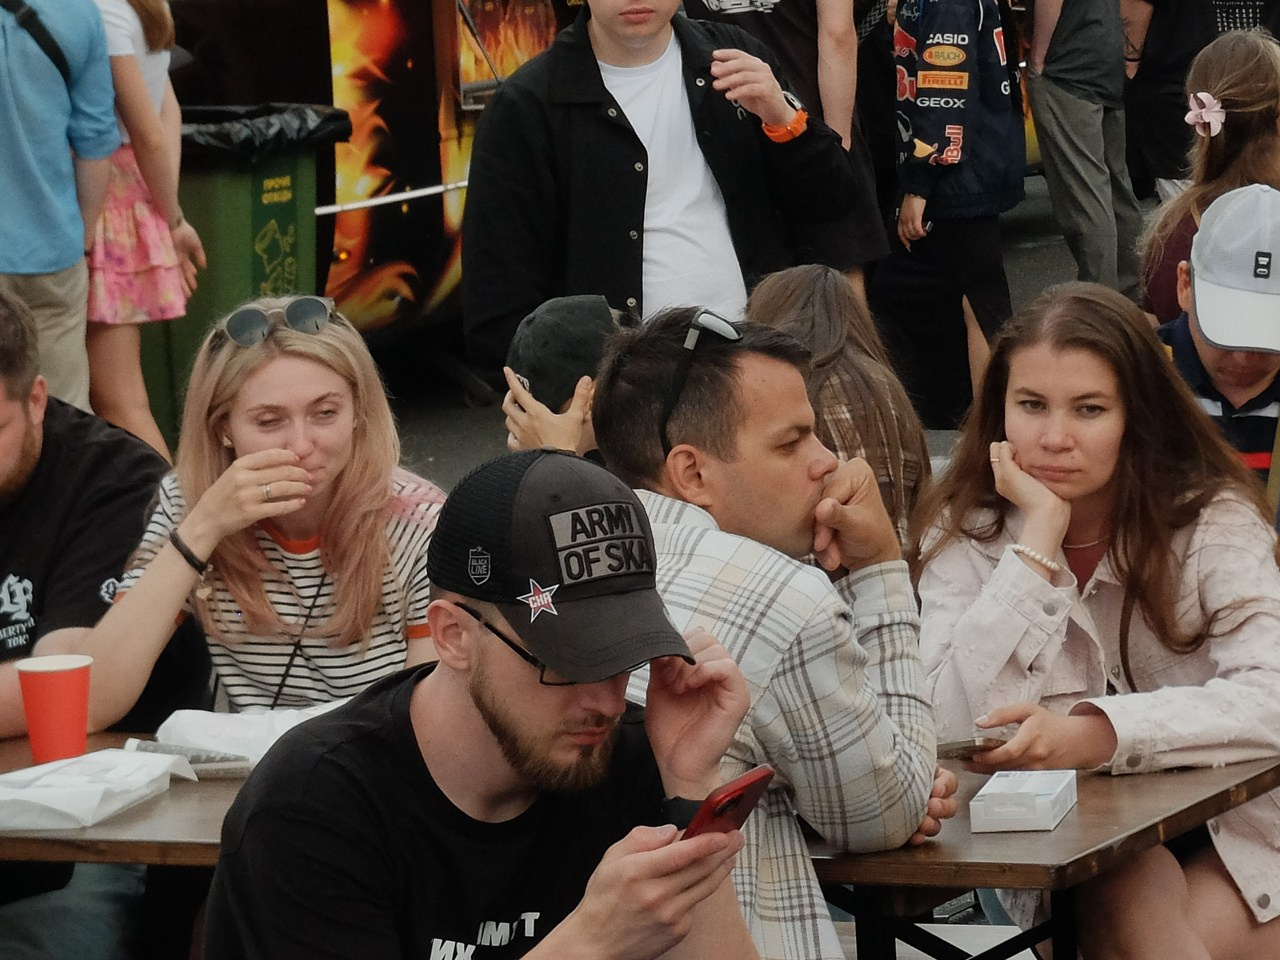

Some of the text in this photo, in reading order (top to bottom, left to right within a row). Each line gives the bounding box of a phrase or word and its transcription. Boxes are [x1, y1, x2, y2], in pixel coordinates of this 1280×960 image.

[922, 74, 964, 86] PIRELLI
[916, 97, 967, 108] GEOX
[570, 504, 635, 542] ARMY
[563, 540, 653, 581] OF SKA
[471, 565, 488, 575] LINE
